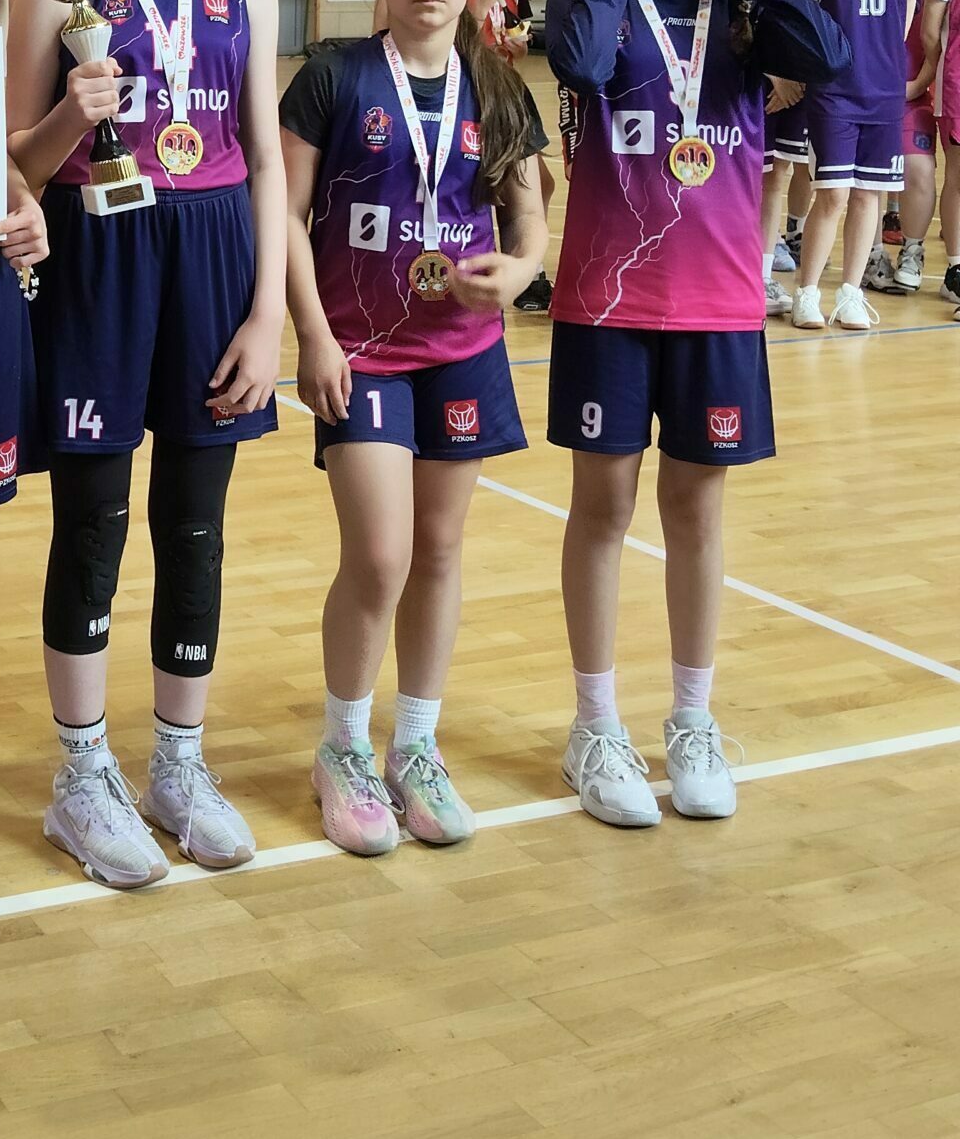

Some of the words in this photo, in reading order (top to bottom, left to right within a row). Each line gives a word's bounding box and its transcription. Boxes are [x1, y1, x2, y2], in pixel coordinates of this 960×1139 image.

[157, 88, 229, 121] smup
[666, 123, 742, 155] smup
[64, 398, 103, 440] 14
[366, 390, 383, 429] 1
[581, 401, 603, 440] 9
[451, 434, 477, 444] PZKosz
[713, 441, 739, 450] PZKosz
[185, 644, 207, 661] NBA
